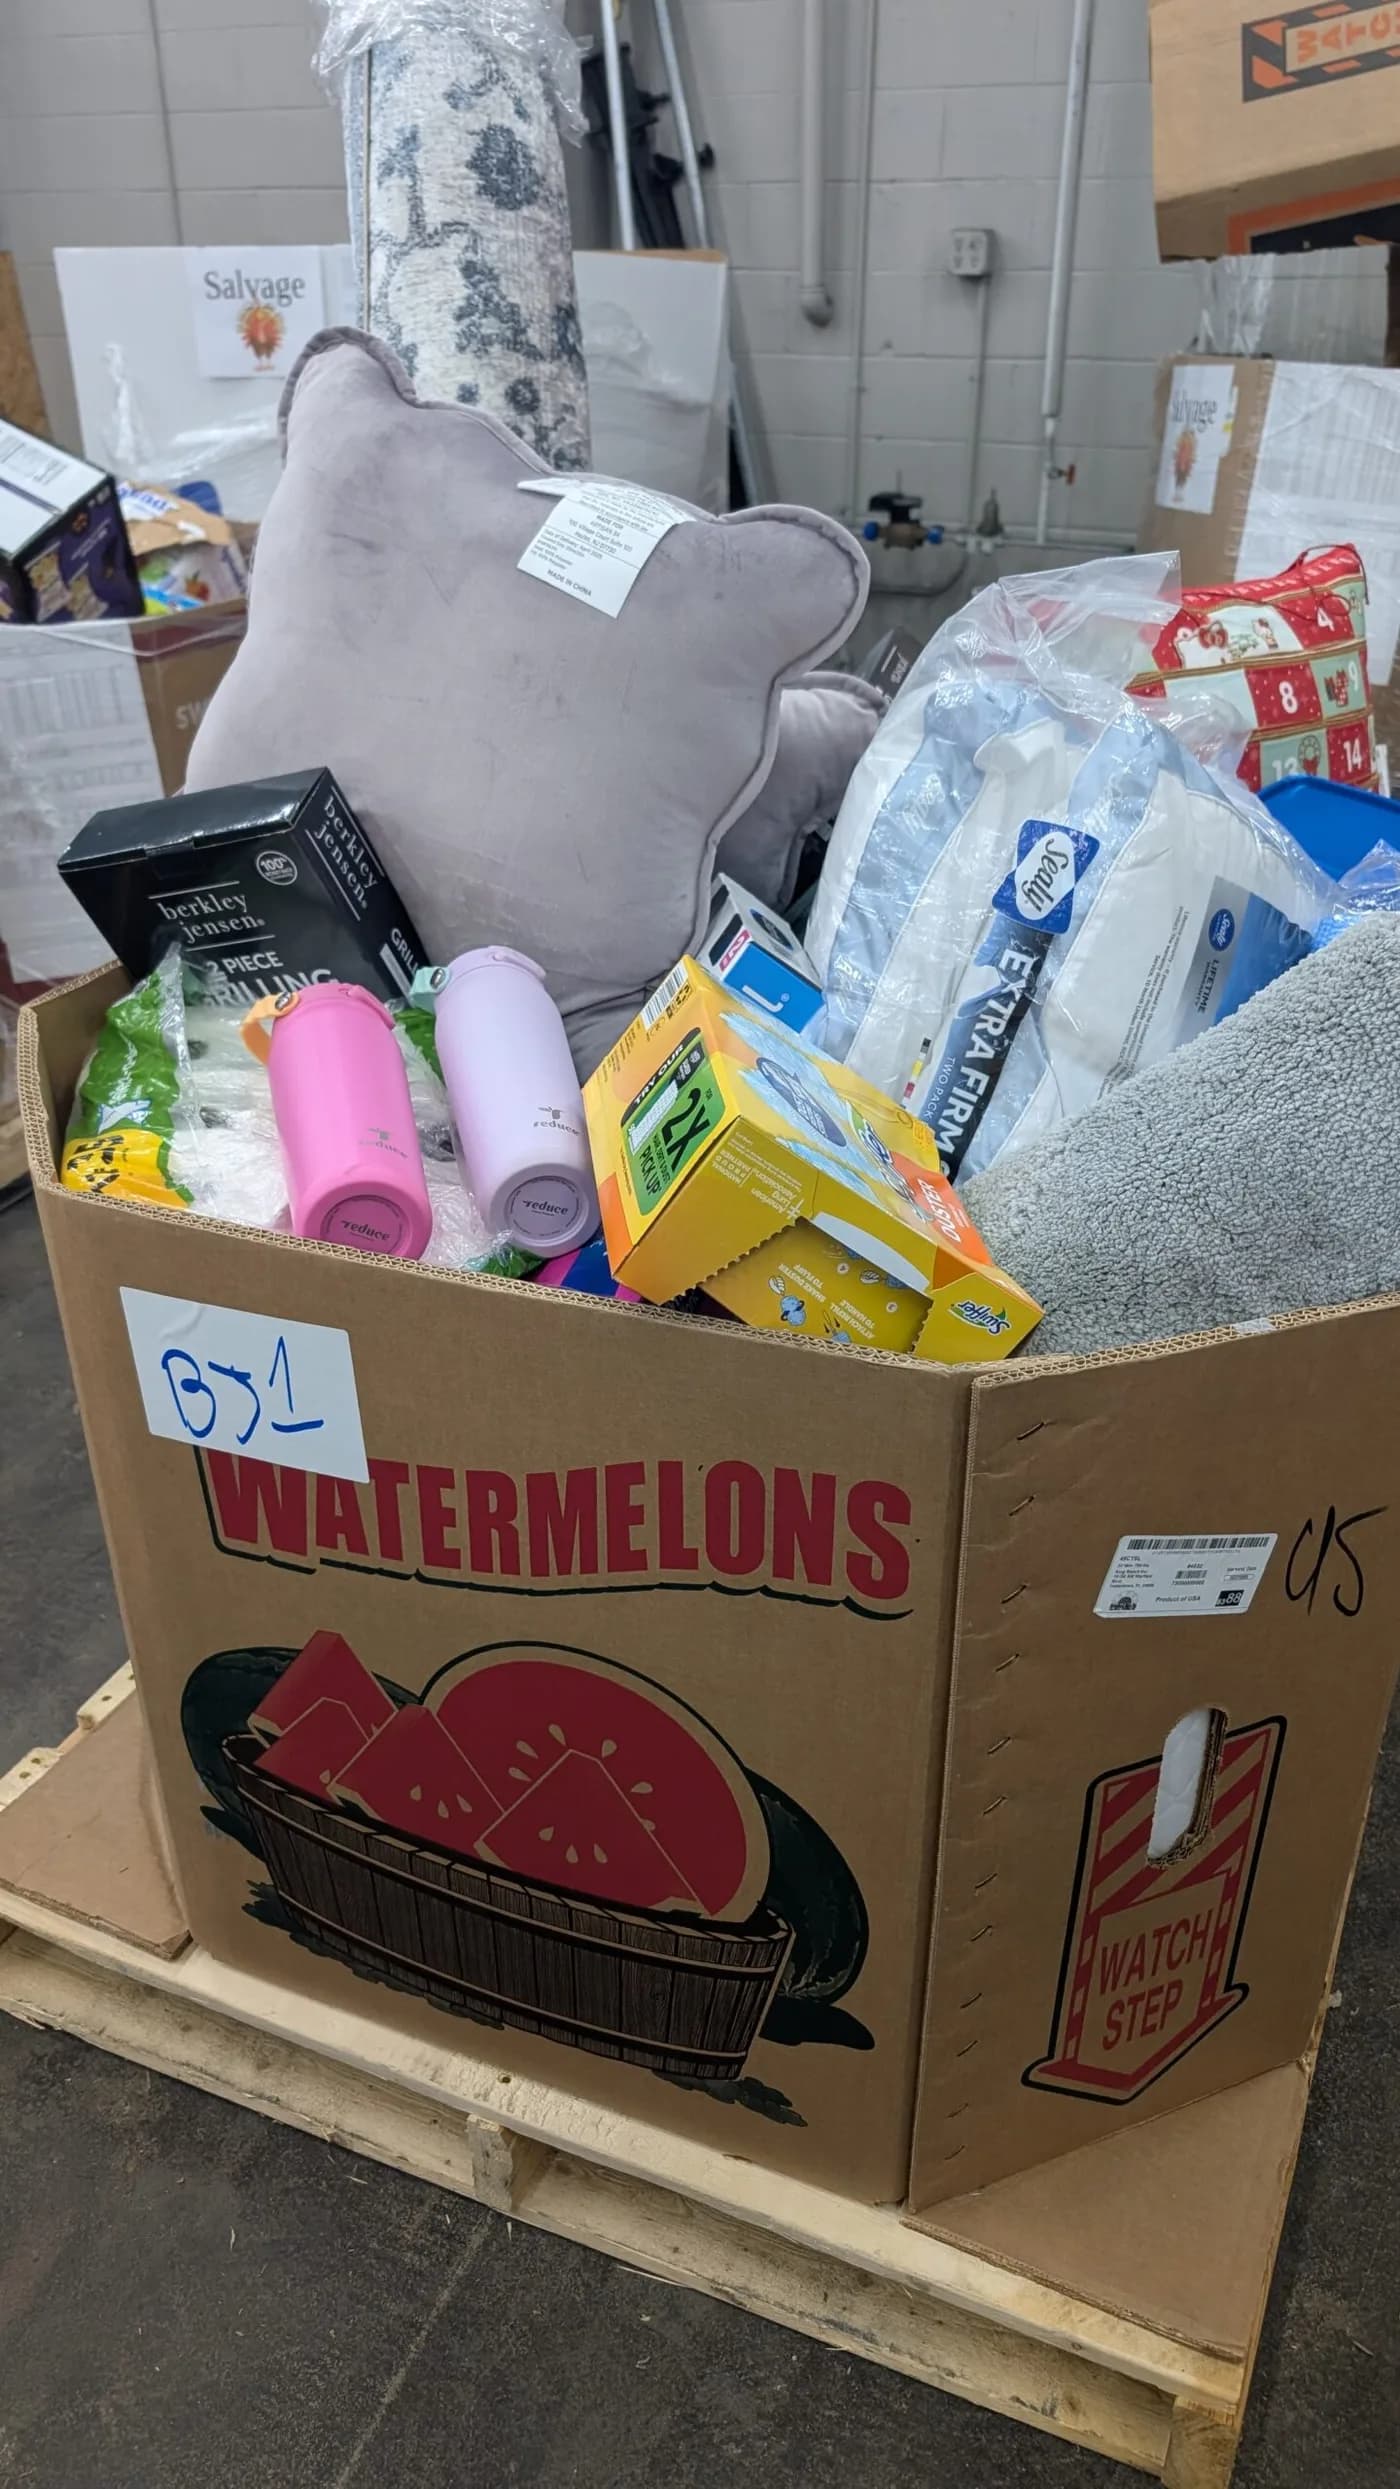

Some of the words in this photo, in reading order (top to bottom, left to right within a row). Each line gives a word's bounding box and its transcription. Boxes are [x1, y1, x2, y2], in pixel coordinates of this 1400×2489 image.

[1296, 4, 1400, 64] WATC
[203, 269, 306, 307] Salvage
[547, 569, 565, 582] MADE
[565, 578, 573, 586] IN
[572, 582, 592, 597] CHINA
[1317, 607, 1335, 632] 4
[1279, 680, 1298, 714] 8
[1343, 737, 1362, 774] 14
[323, 796, 378, 889] berkley
[314, 819, 368, 905] jensen
[1019, 838, 1070, 915] Sealy
[157, 894, 249, 920] berkley
[179, 915, 259, 944] jensen
[223, 951, 284, 975] PIECE
[1199, 958, 1220, 1014] LIFETIME
[964, 948, 1033, 1061] EXTRA
[635, 1074, 656, 1105] TRY
[657, 1043, 684, 1076] OUR
[938, 1056, 955, 1085] TWO
[924, 1088, 944, 1118] PACK
[933, 1068, 988, 1157] FIRM
[532, 1119, 582, 1137] reduce
[661, 1086, 711, 1172] 2X
[639, 1144, 655, 1180] PICK
[522, 1199, 570, 1217] reduce
[751, 1187, 786, 1213] American
[770, 1190, 790, 1206] Lung
[340, 1219, 391, 1242] reduce
[829, 1302, 853, 1322] REFILL
[840, 1299, 865, 1322] HANDLE
[959, 1299, 1011, 1335] Swiffer
[851, 1318, 876, 1339] ATTACH
[207, 1448, 911, 1599] WATERMELONS
[1155, 1594, 1180, 1604] Product
[1188, 1594, 1202, 1603] USA
[1225, 1591, 1243, 1605] 88
[1100, 1908, 1214, 1996] WATCH
[1102, 1978, 1183, 2050] STEP
